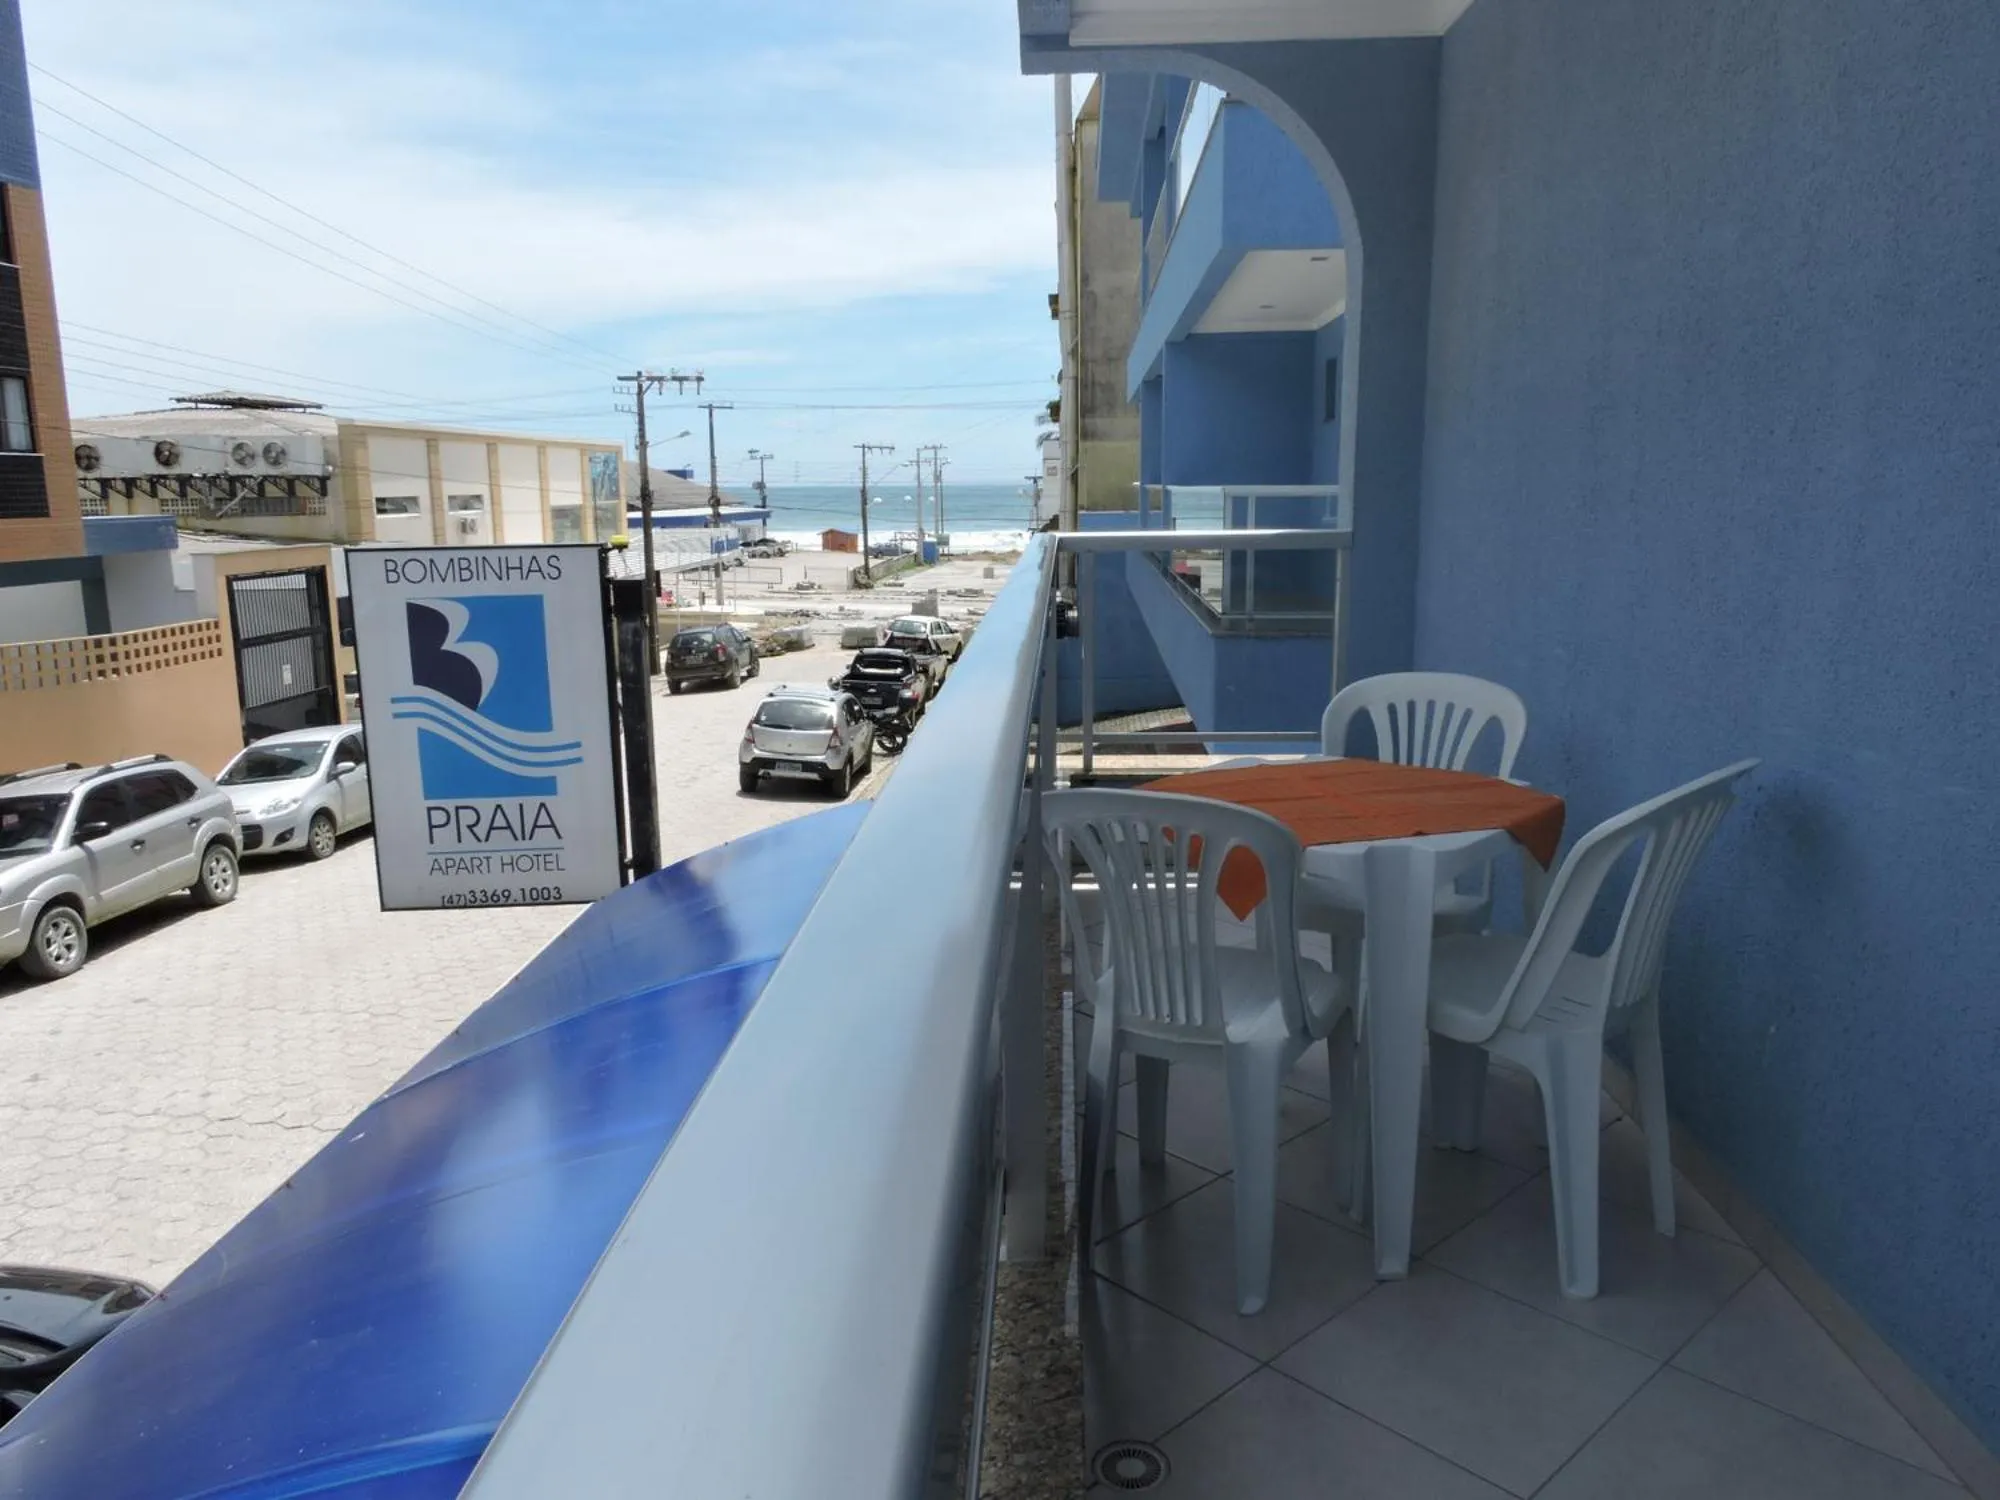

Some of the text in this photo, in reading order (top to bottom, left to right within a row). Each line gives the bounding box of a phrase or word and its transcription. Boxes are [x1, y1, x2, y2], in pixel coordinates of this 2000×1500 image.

[384, 555, 562, 584] BOMBINHAS
[426, 802, 563, 844] PRAIA
[429, 853, 566, 876] APART HOTEL
